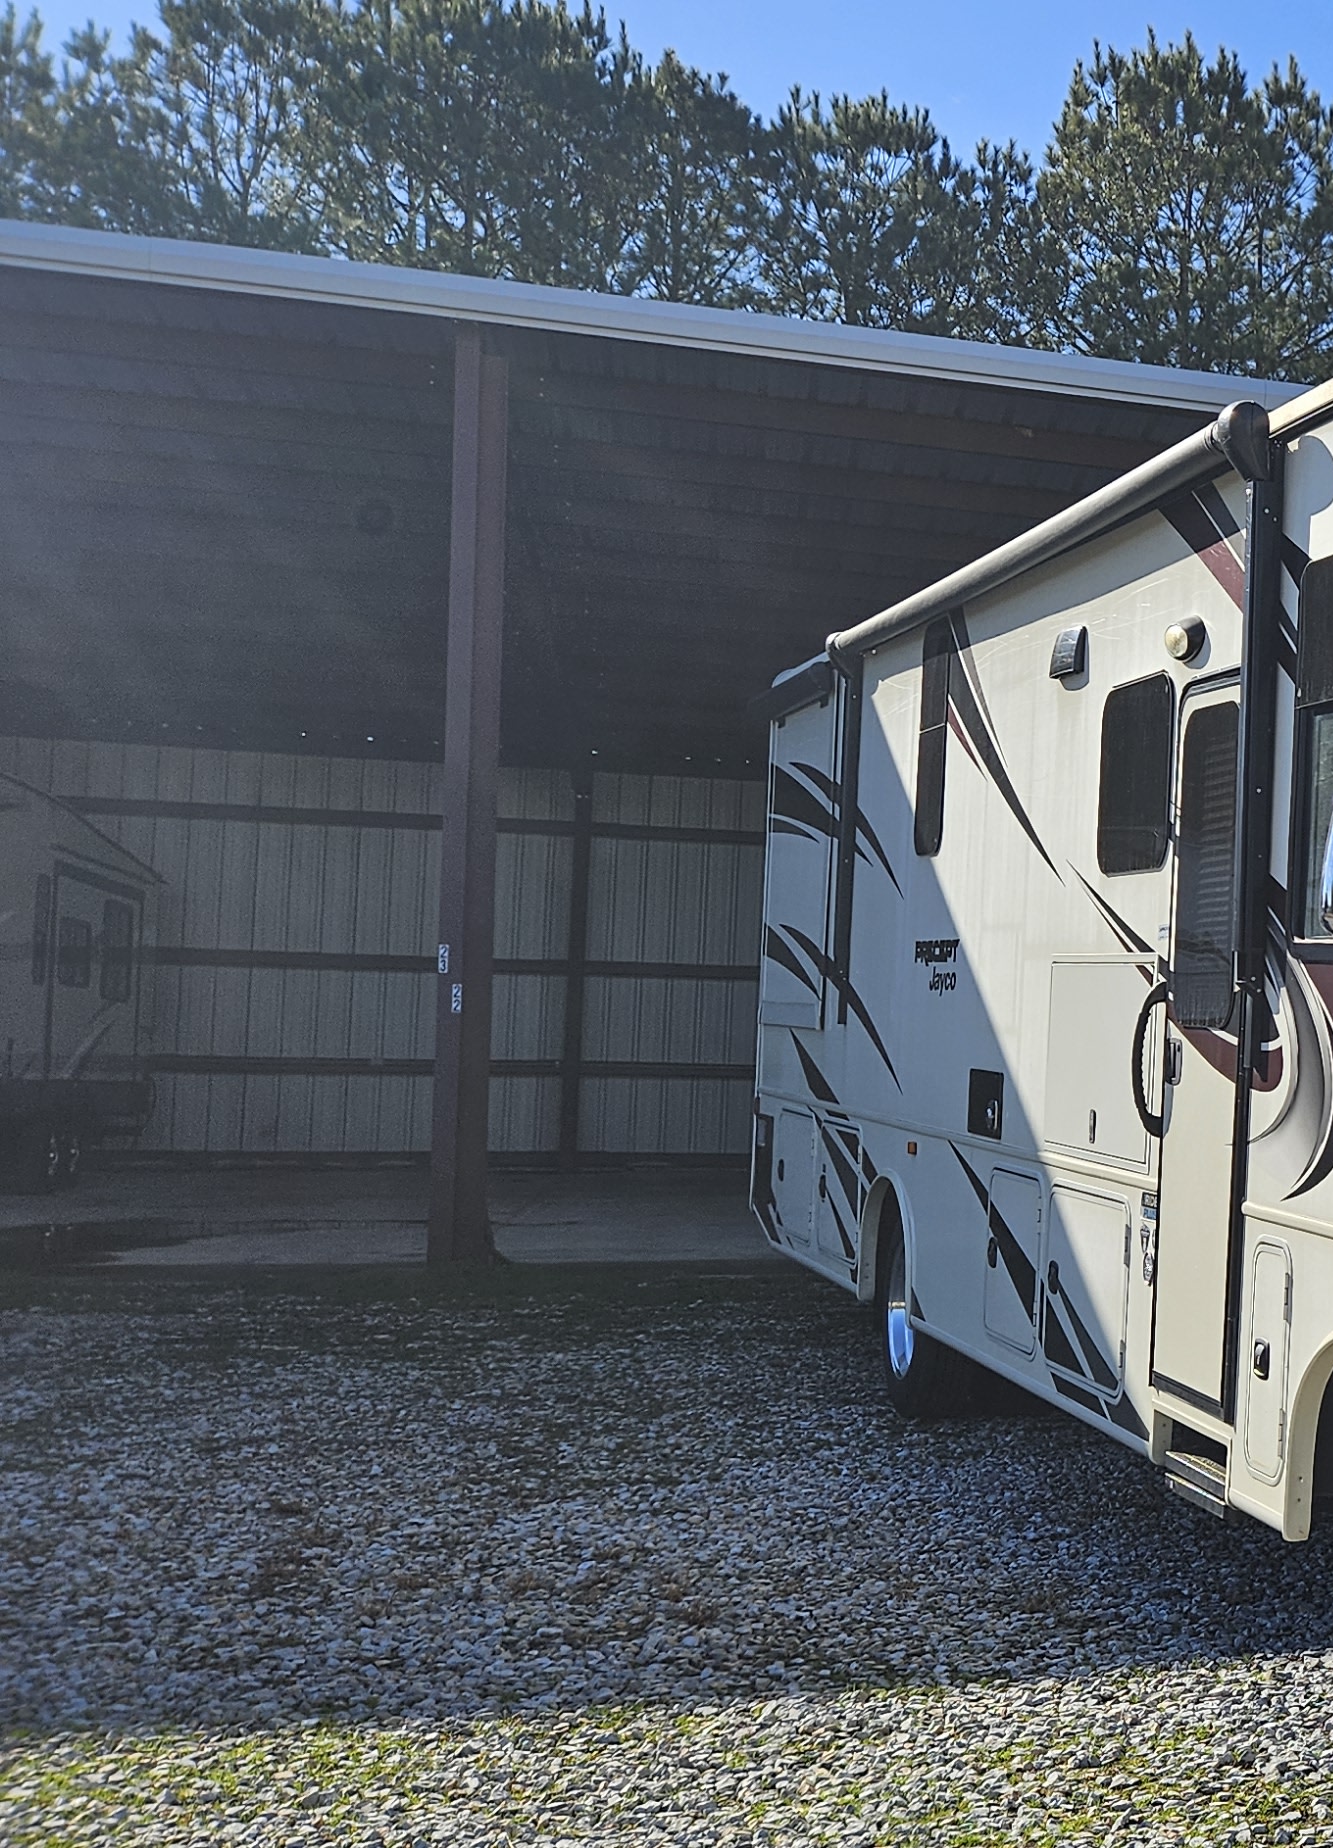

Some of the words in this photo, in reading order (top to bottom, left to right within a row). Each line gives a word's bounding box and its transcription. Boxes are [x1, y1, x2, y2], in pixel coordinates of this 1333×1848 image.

[439, 945, 448, 972] 23
[914, 938, 960, 967] PRECEPT
[929, 966, 957, 997] Jayco
[453, 985, 461, 1012] 22
